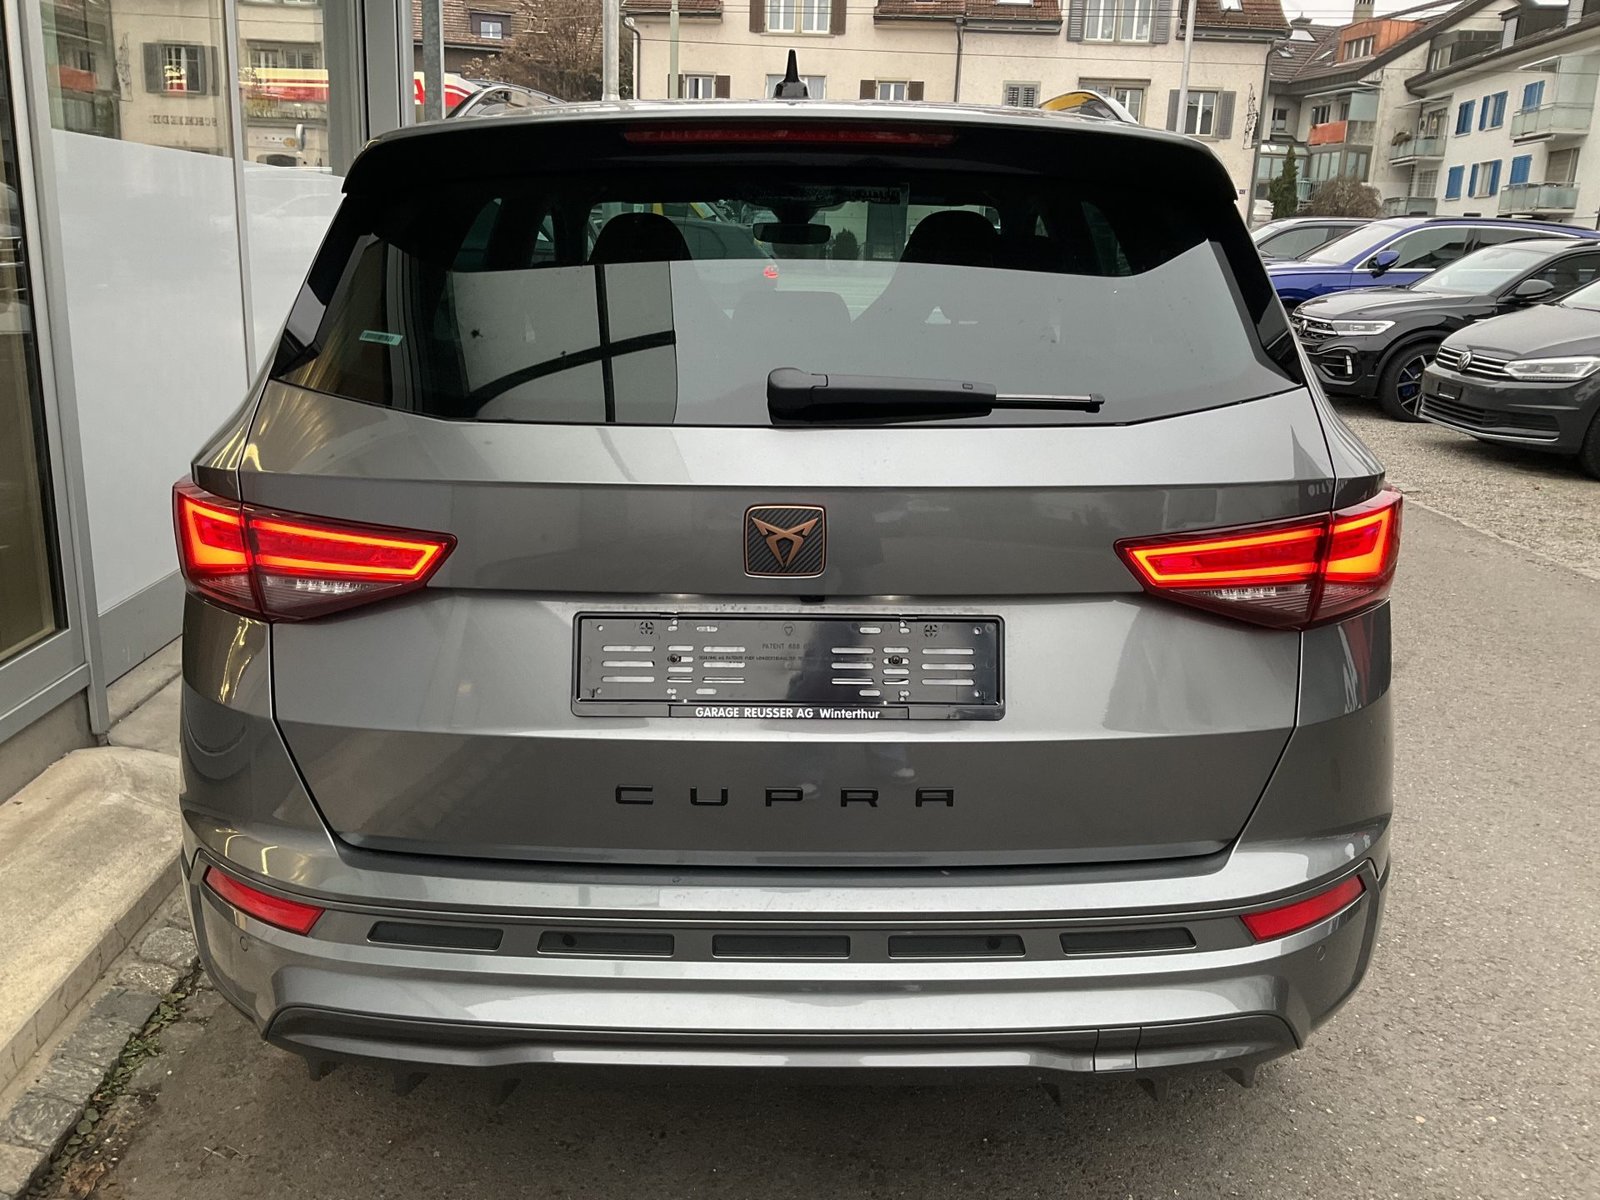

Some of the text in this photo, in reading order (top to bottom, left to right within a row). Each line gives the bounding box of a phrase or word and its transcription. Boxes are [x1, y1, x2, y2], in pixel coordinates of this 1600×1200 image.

[695, 707, 881, 719] GARAGE REUSSER AG Winterthur
[615, 784, 955, 808] CUPRA
